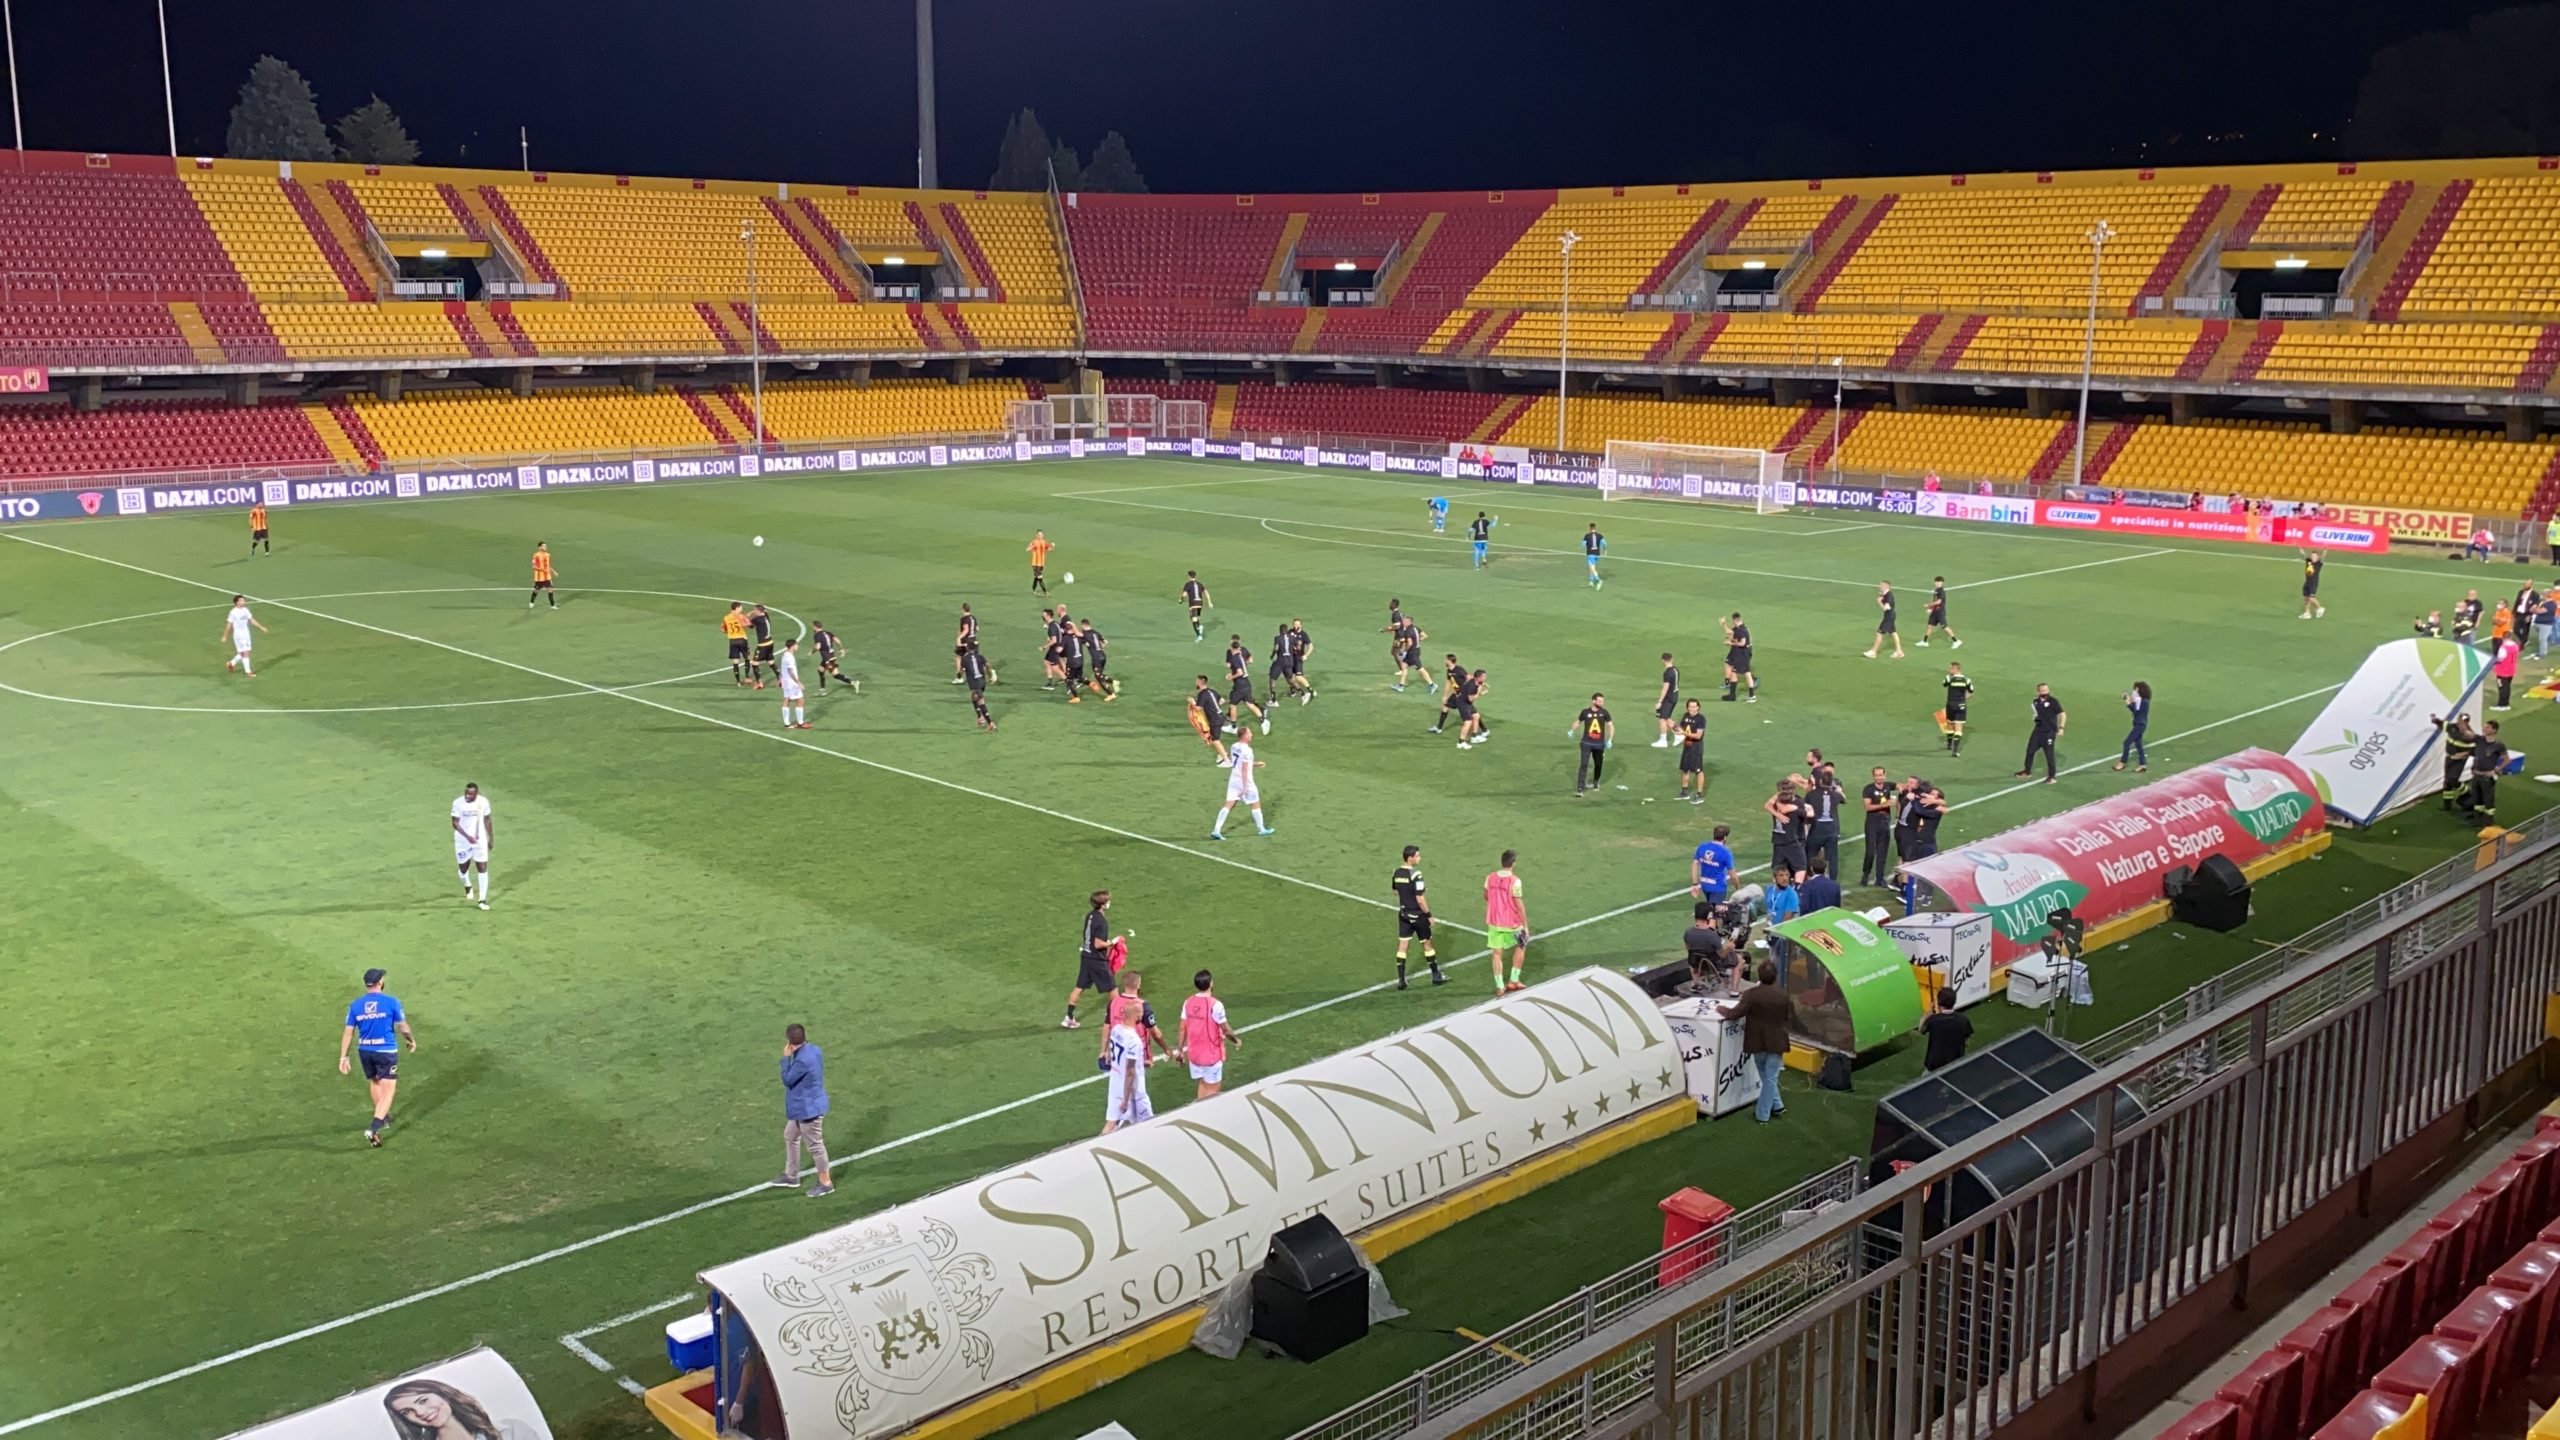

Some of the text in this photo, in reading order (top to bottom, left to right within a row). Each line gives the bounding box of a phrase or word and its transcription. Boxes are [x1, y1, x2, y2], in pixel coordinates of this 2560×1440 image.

[861, 450, 926, 466] DAZN.COM
[951, 446, 1012, 462] DAZN.COM
[1255, 446, 1303, 461] DAZN.COM
[1319, 451, 1370, 467] DAZN.COM
[1530, 452, 1567, 466] vitale
[659, 460, 735, 477] DAZN.COM
[764, 456, 835, 472] DAZN.COM
[1387, 456, 1440, 473] DAZN.COM
[426, 472, 513, 491] DAZN.COM
[546, 466, 629, 484] DAZN.COM
[1536, 468, 1597, 485] DAZN.COM
[1618, 473, 1681, 491] DAZN.COM
[153, 487, 256, 508] DAZN.COM
[296, 480, 390, 500] DAZN.COM
[1703, 480, 1773, 498] DAZN.COM
[1797, 487, 1873, 506] DAZN.COM
[1878, 500, 1914, 514] 45:00
[1945, 502, 2028, 523] Bambini
[2111, 514, 2169, 529] specialisti
[2173, 518, 2184, 528] in
[2248, 798, 2301, 841] MAURO
[2056, 829, 2113, 857] Dalla
[2099, 814, 2152, 839] Valle
[2096, 824, 2225, 887] Natura e Sapore
[978, 974, 1665, 1295] SAMNIUM
[1040, 1130, 1501, 1356] RESORT SUITES
